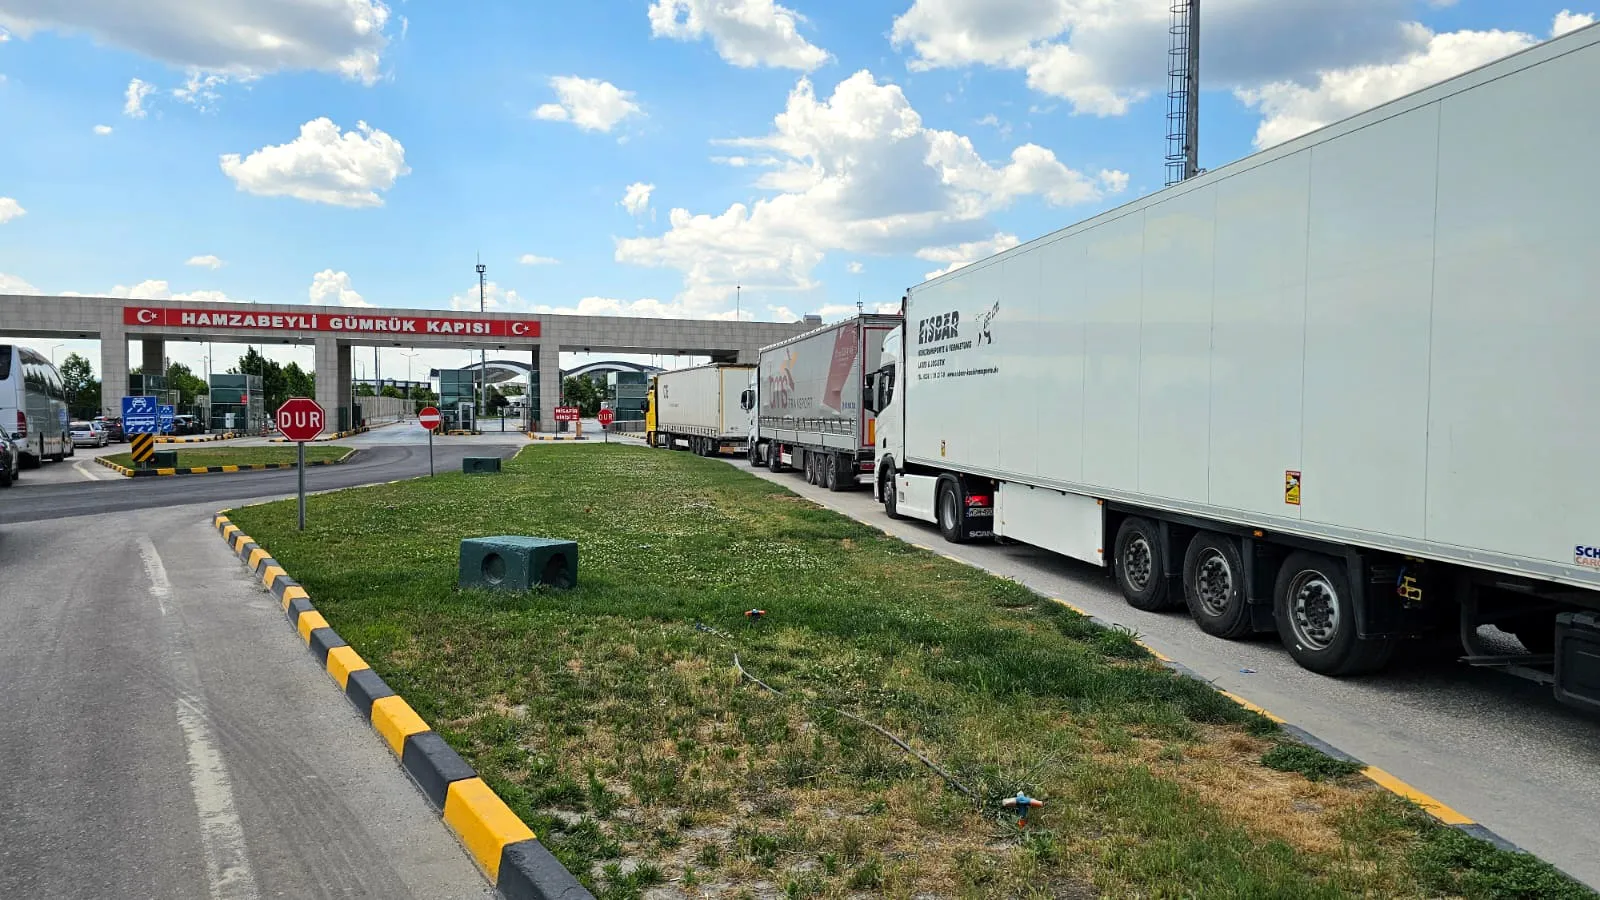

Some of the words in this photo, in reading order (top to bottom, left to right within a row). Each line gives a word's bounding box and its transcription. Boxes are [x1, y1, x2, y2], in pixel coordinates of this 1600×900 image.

[181, 312, 317, 329] HAMZABEYLİ
[329, 316, 416, 332] GÜMRÜK
[427, 320, 490, 334] KAPISI
[281, 411, 321, 428] DUR
